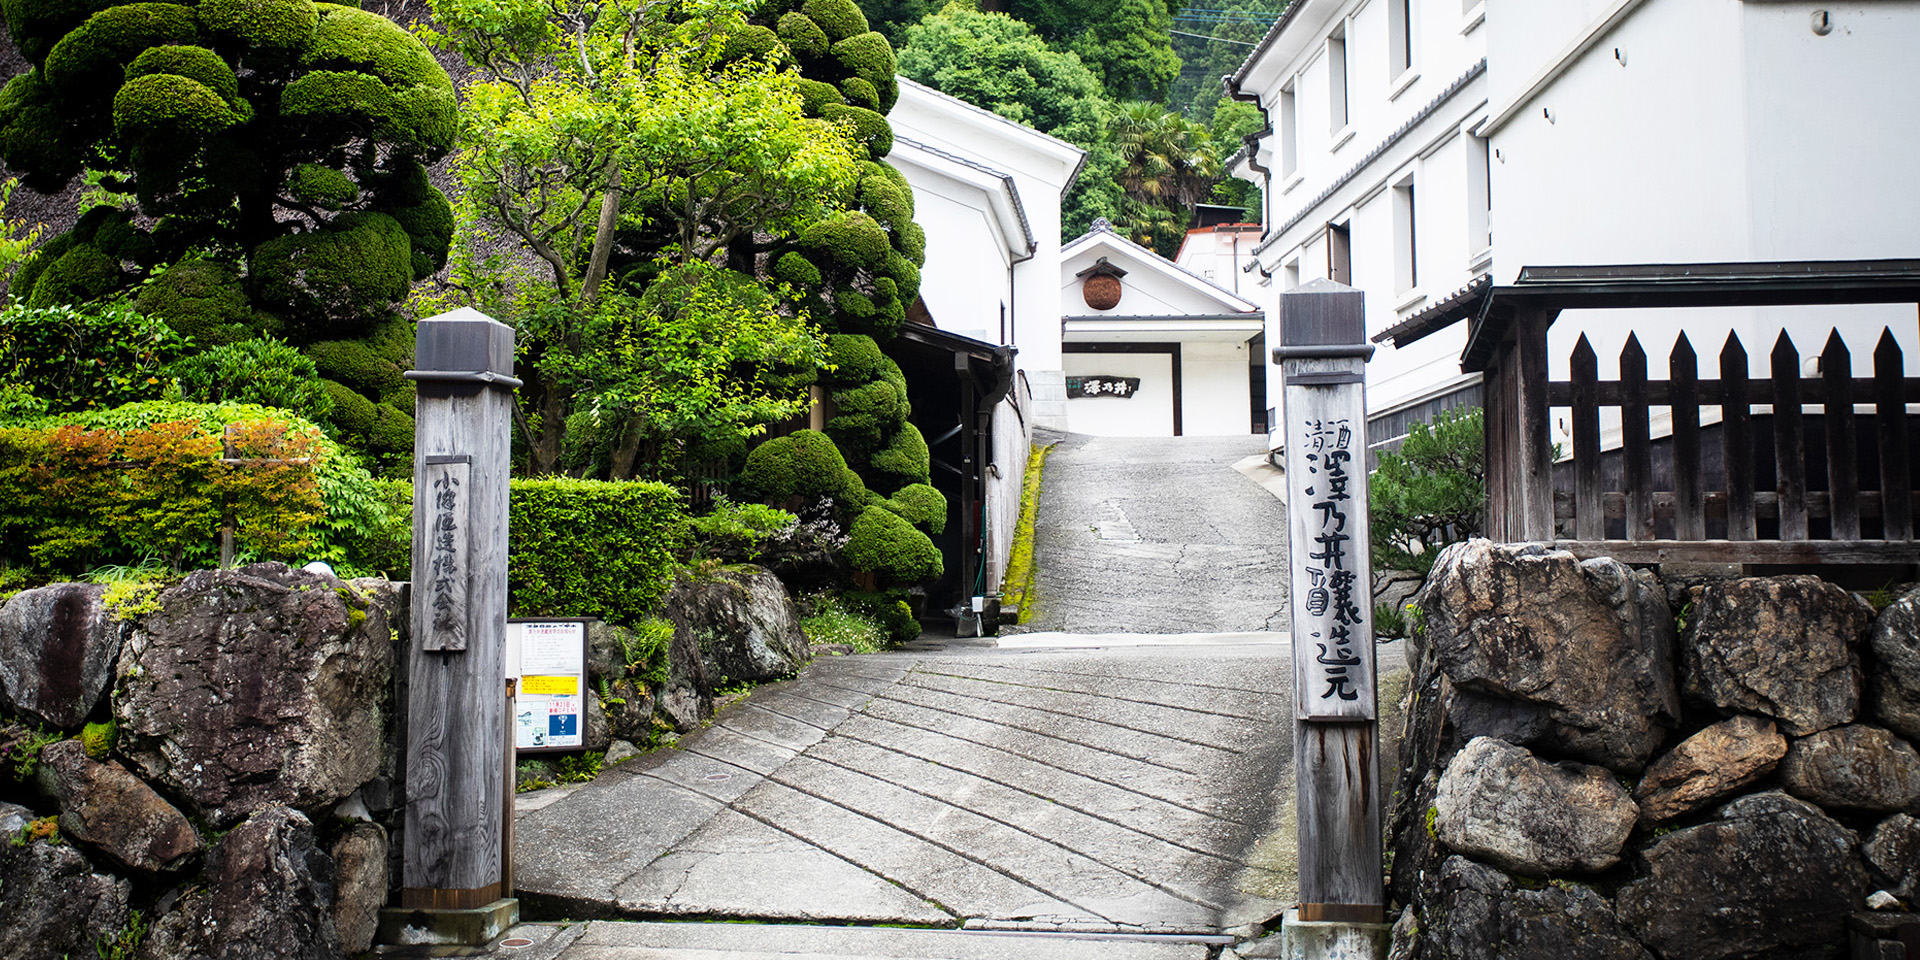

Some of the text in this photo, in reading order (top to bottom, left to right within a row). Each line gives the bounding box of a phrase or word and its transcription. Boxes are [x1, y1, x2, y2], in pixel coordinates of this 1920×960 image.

[1084, 379, 1128, 395] 澤乃井
[1303, 419, 1352, 453] 清酒
